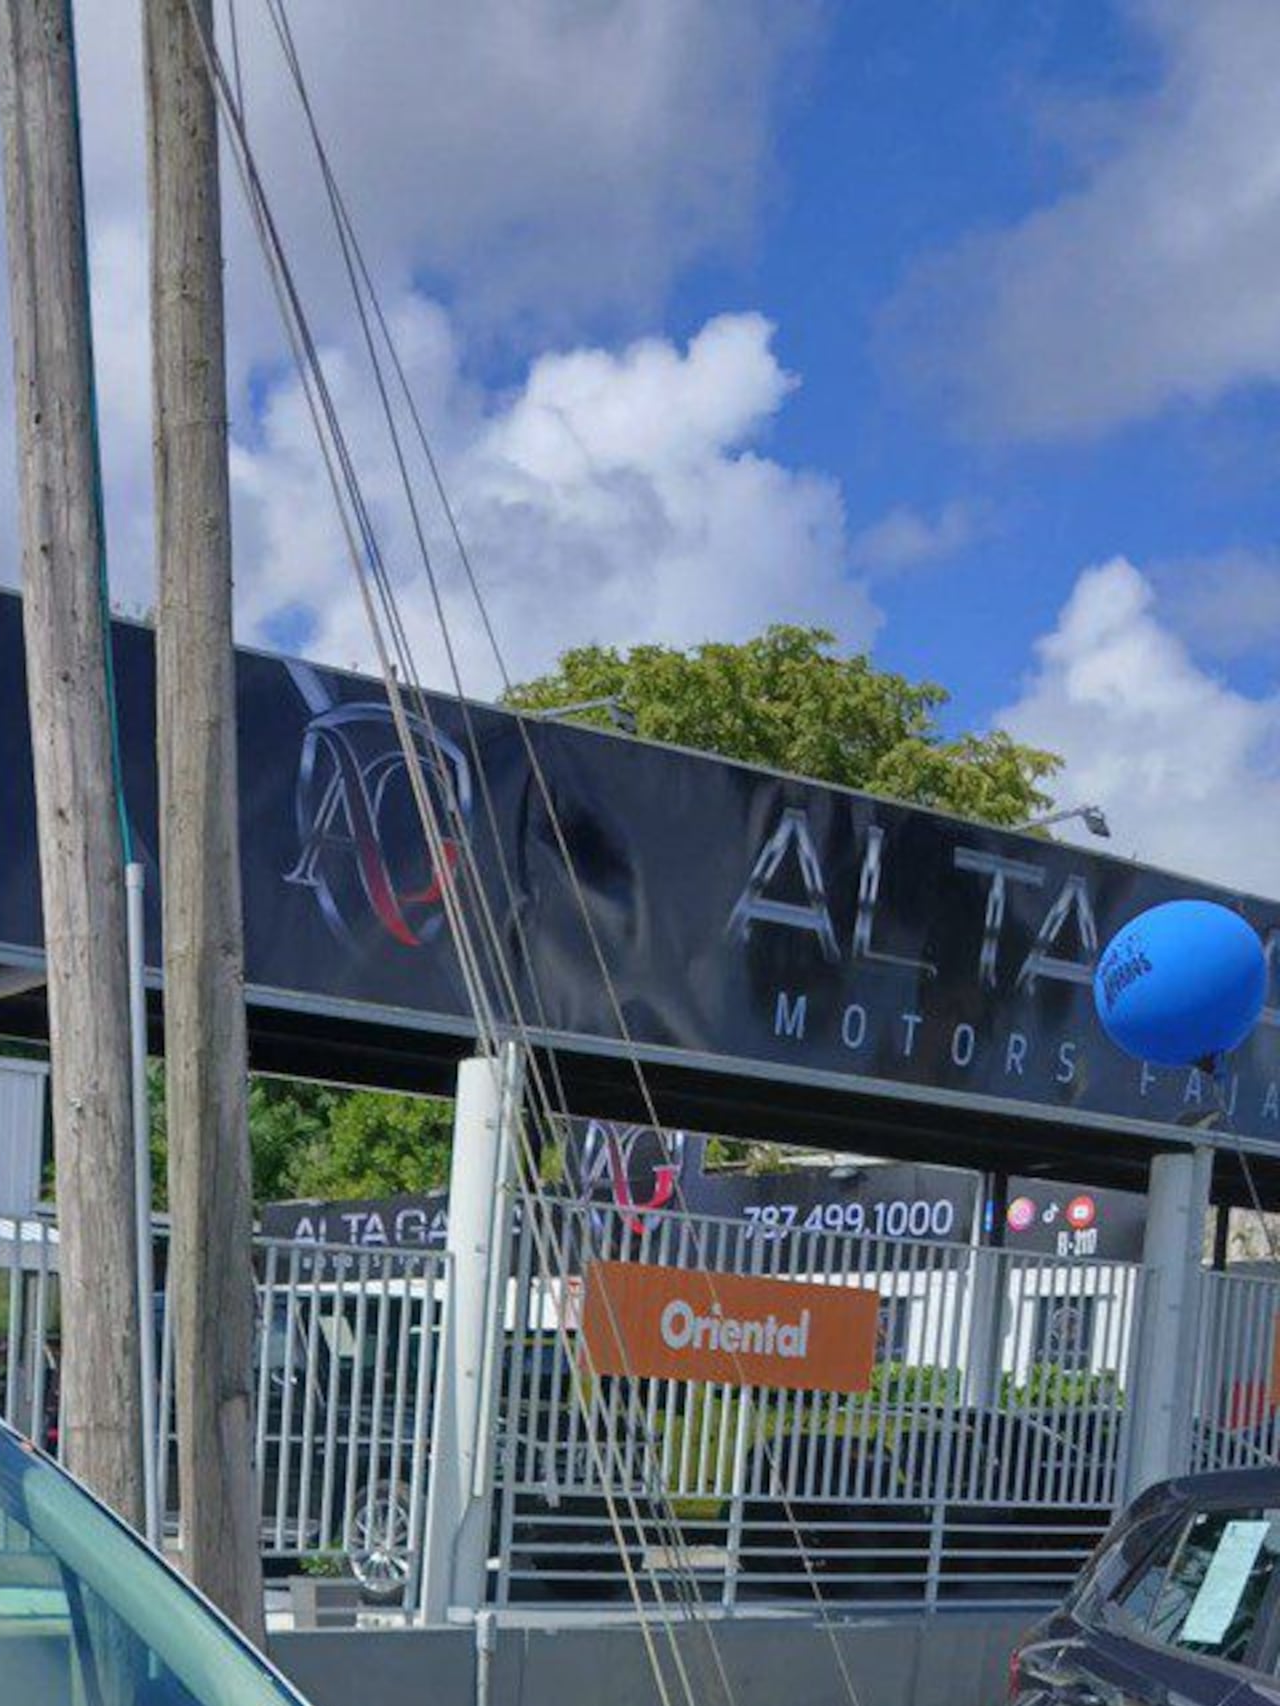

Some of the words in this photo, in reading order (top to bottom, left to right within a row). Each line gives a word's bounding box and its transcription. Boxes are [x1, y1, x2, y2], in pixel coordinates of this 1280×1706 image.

[726, 807, 1096, 996] ALTA
[774, 991, 1076, 1083] MOTORS
[660, 1300, 811, 1358] Oriental
